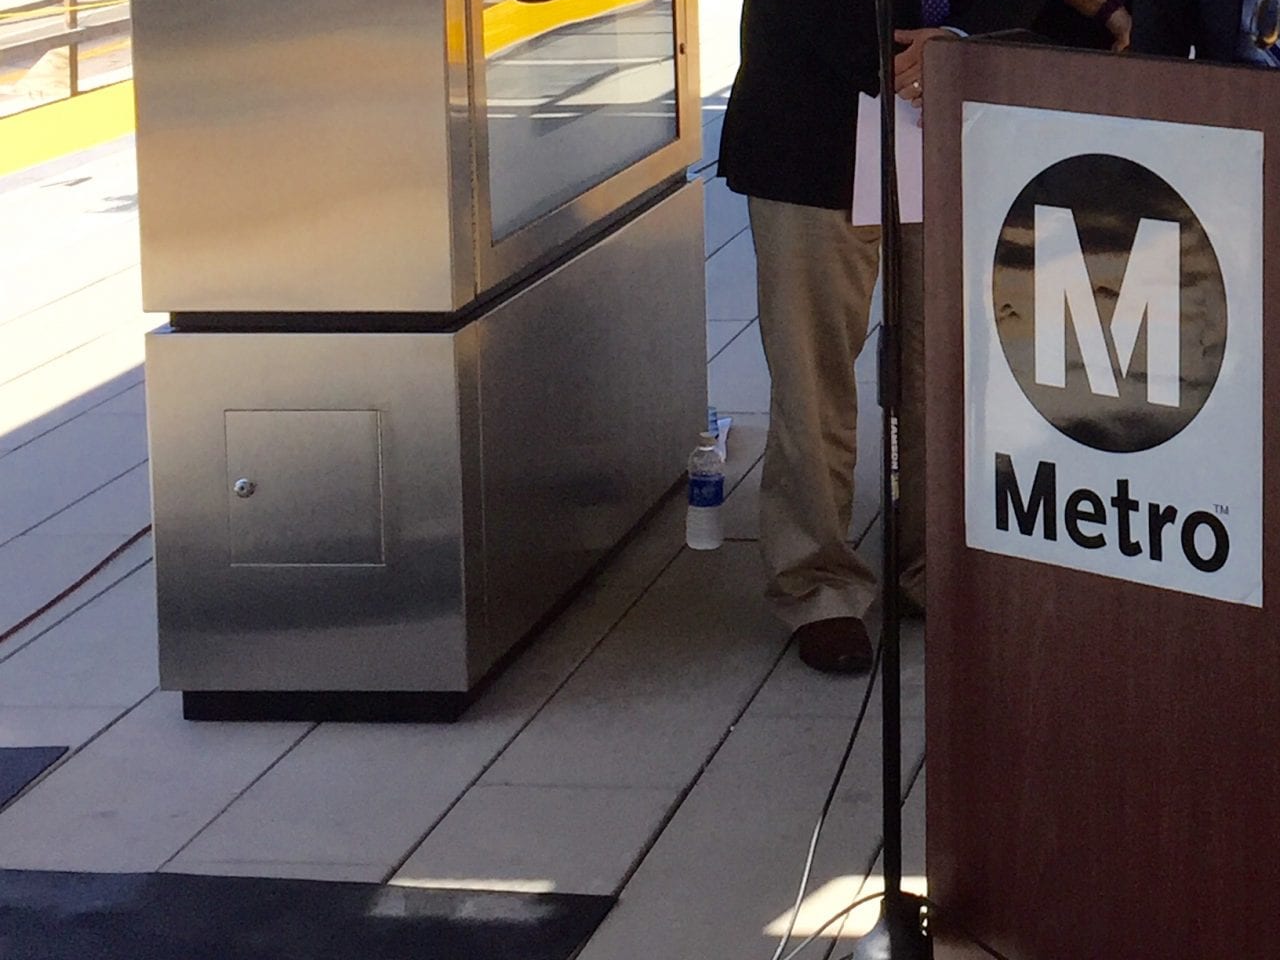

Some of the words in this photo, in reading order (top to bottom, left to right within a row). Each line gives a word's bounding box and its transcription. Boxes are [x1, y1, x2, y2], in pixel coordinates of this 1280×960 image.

[1034, 204, 1181, 408] M
[890, 416, 899, 470] SAMSON
[995, 452, 1230, 573] Metro
